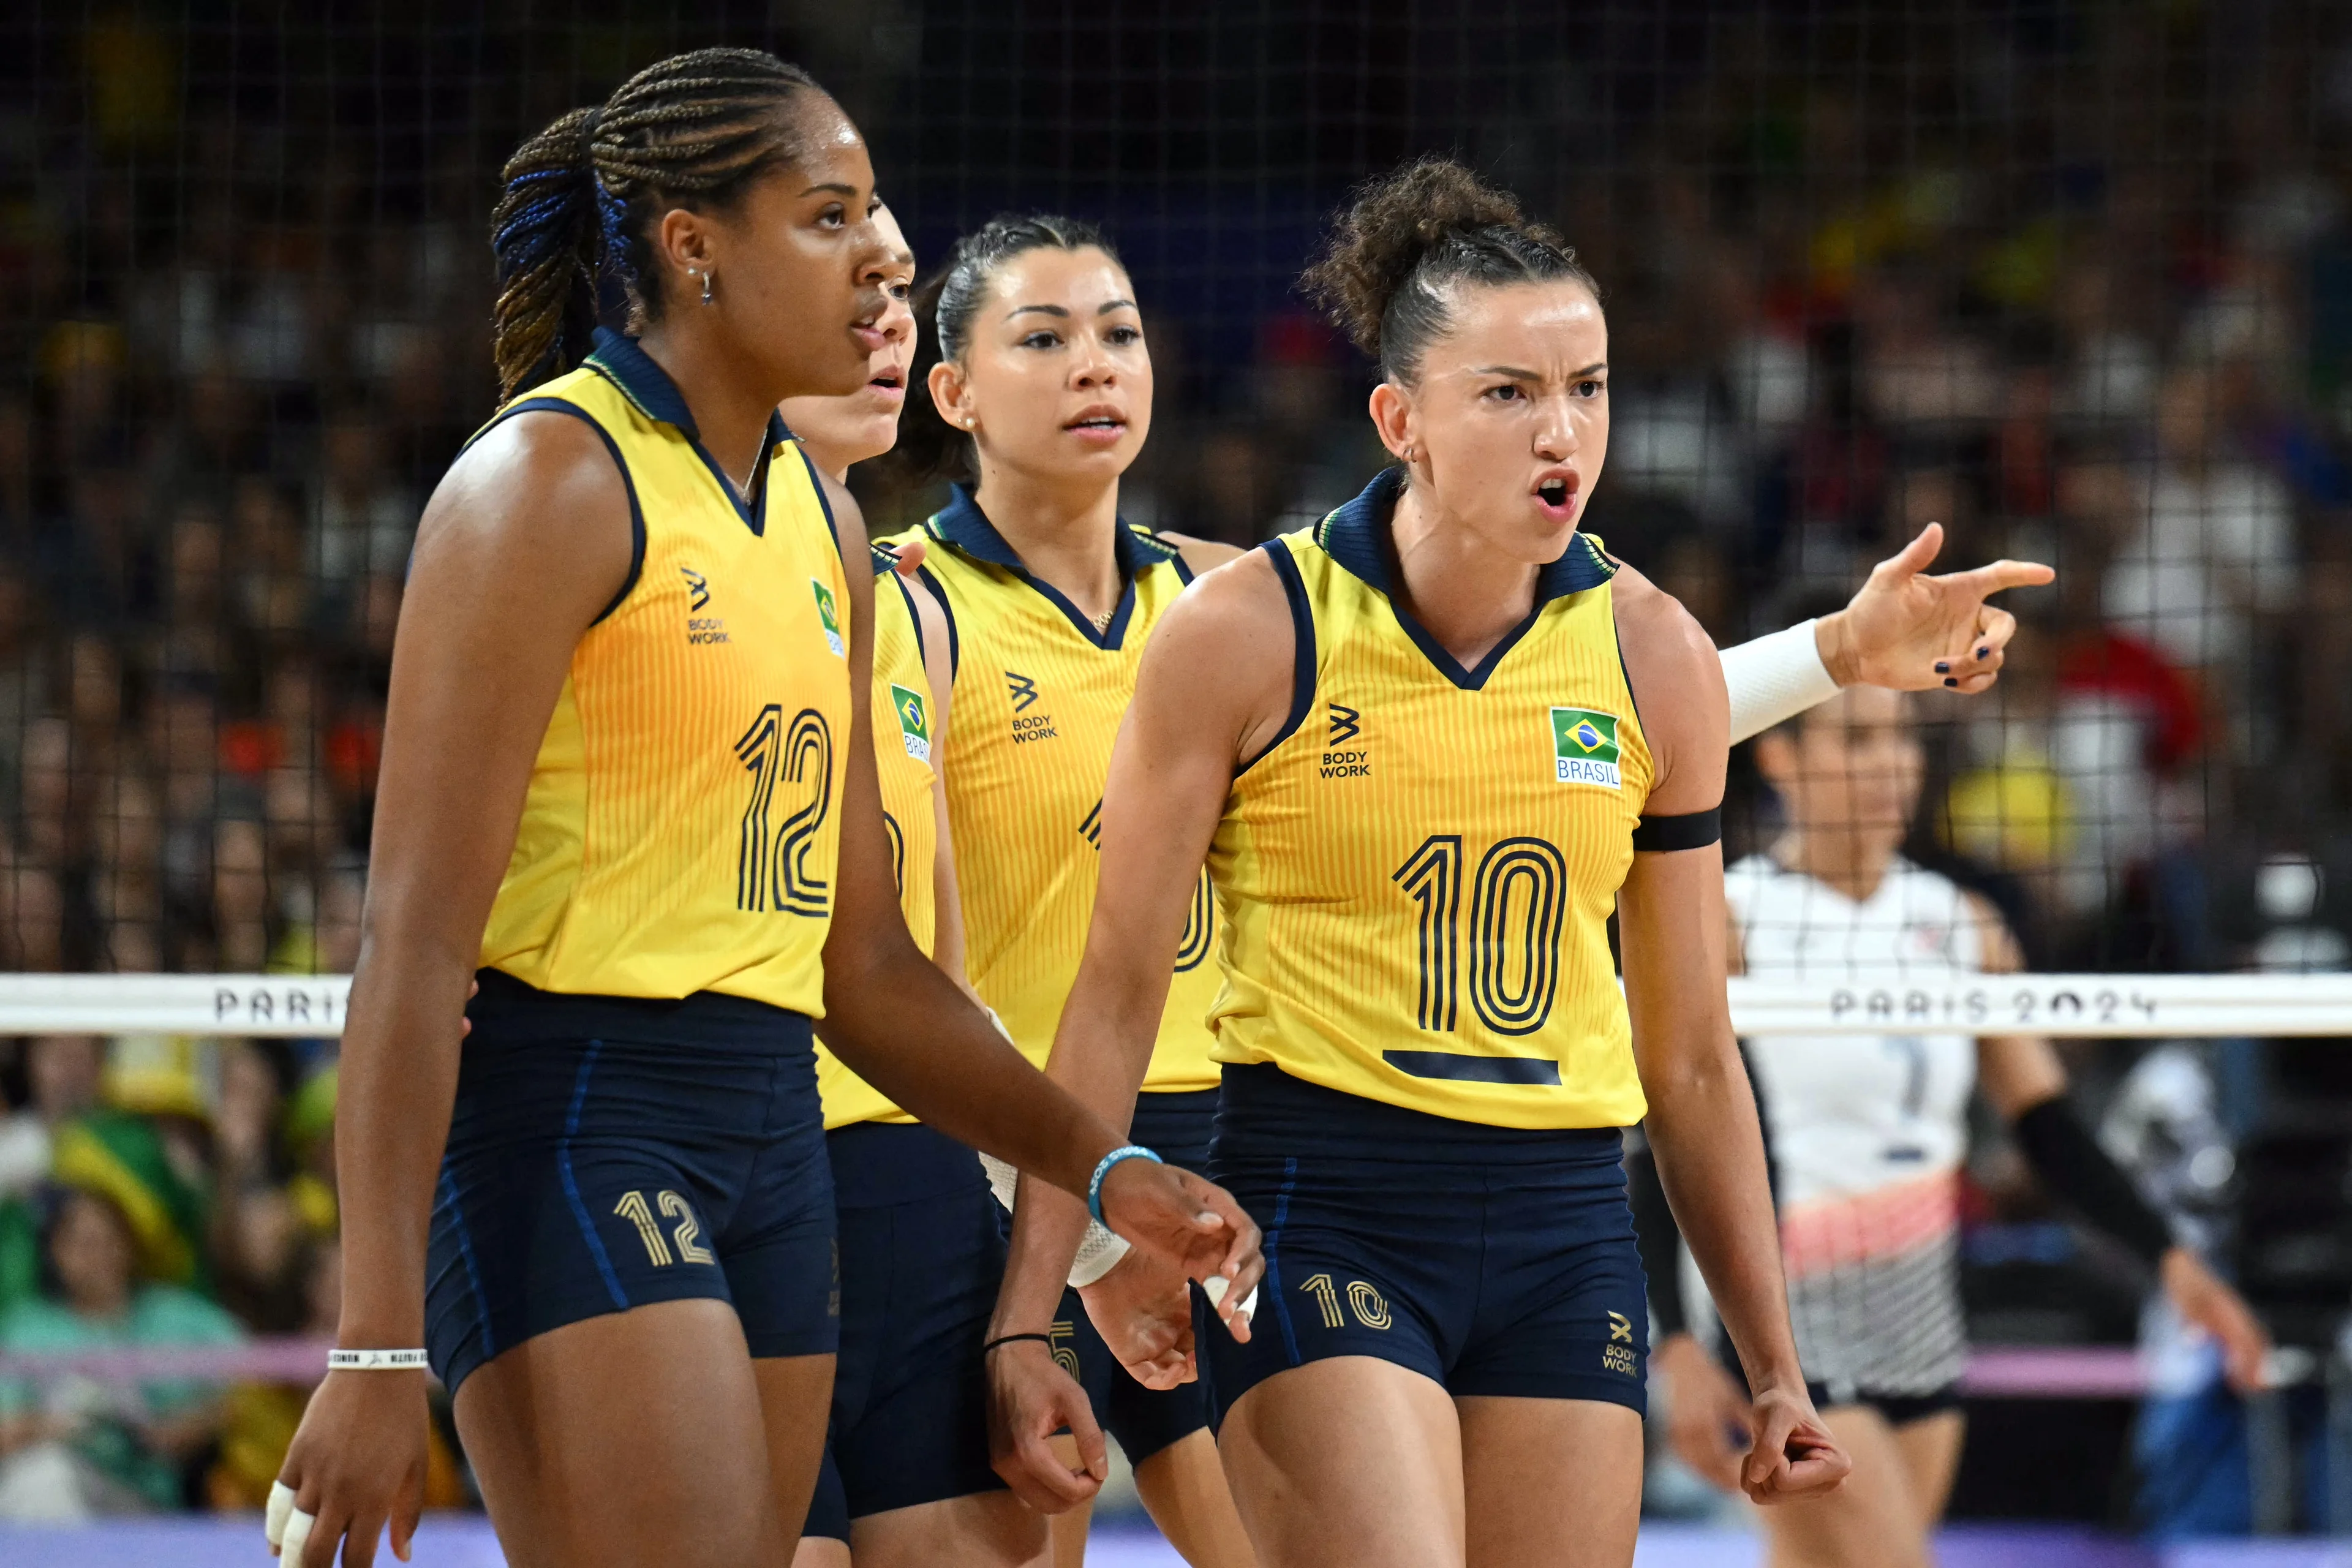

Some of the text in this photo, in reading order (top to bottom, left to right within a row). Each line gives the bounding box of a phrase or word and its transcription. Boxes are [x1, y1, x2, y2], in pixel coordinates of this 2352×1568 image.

[687, 632, 732, 644] WORK
[1012, 715, 1050, 731] BODY
[1012, 727, 1058, 744] WORK
[1323, 751, 1368, 765] BODY
[1319, 764, 1371, 779] WORK
[1558, 760, 1619, 785] BRASIL
[734, 704, 834, 918] 12
[1391, 834, 1567, 1036] 10
[214, 986, 350, 1024] PARI
[1829, 987, 2158, 1025] PARIS 2024
[613, 1189, 715, 1267] 12
[1298, 1273, 1392, 1330] 10
[1606, 1343, 1637, 1364] BODY
[1602, 1355, 1638, 1379] WORK
